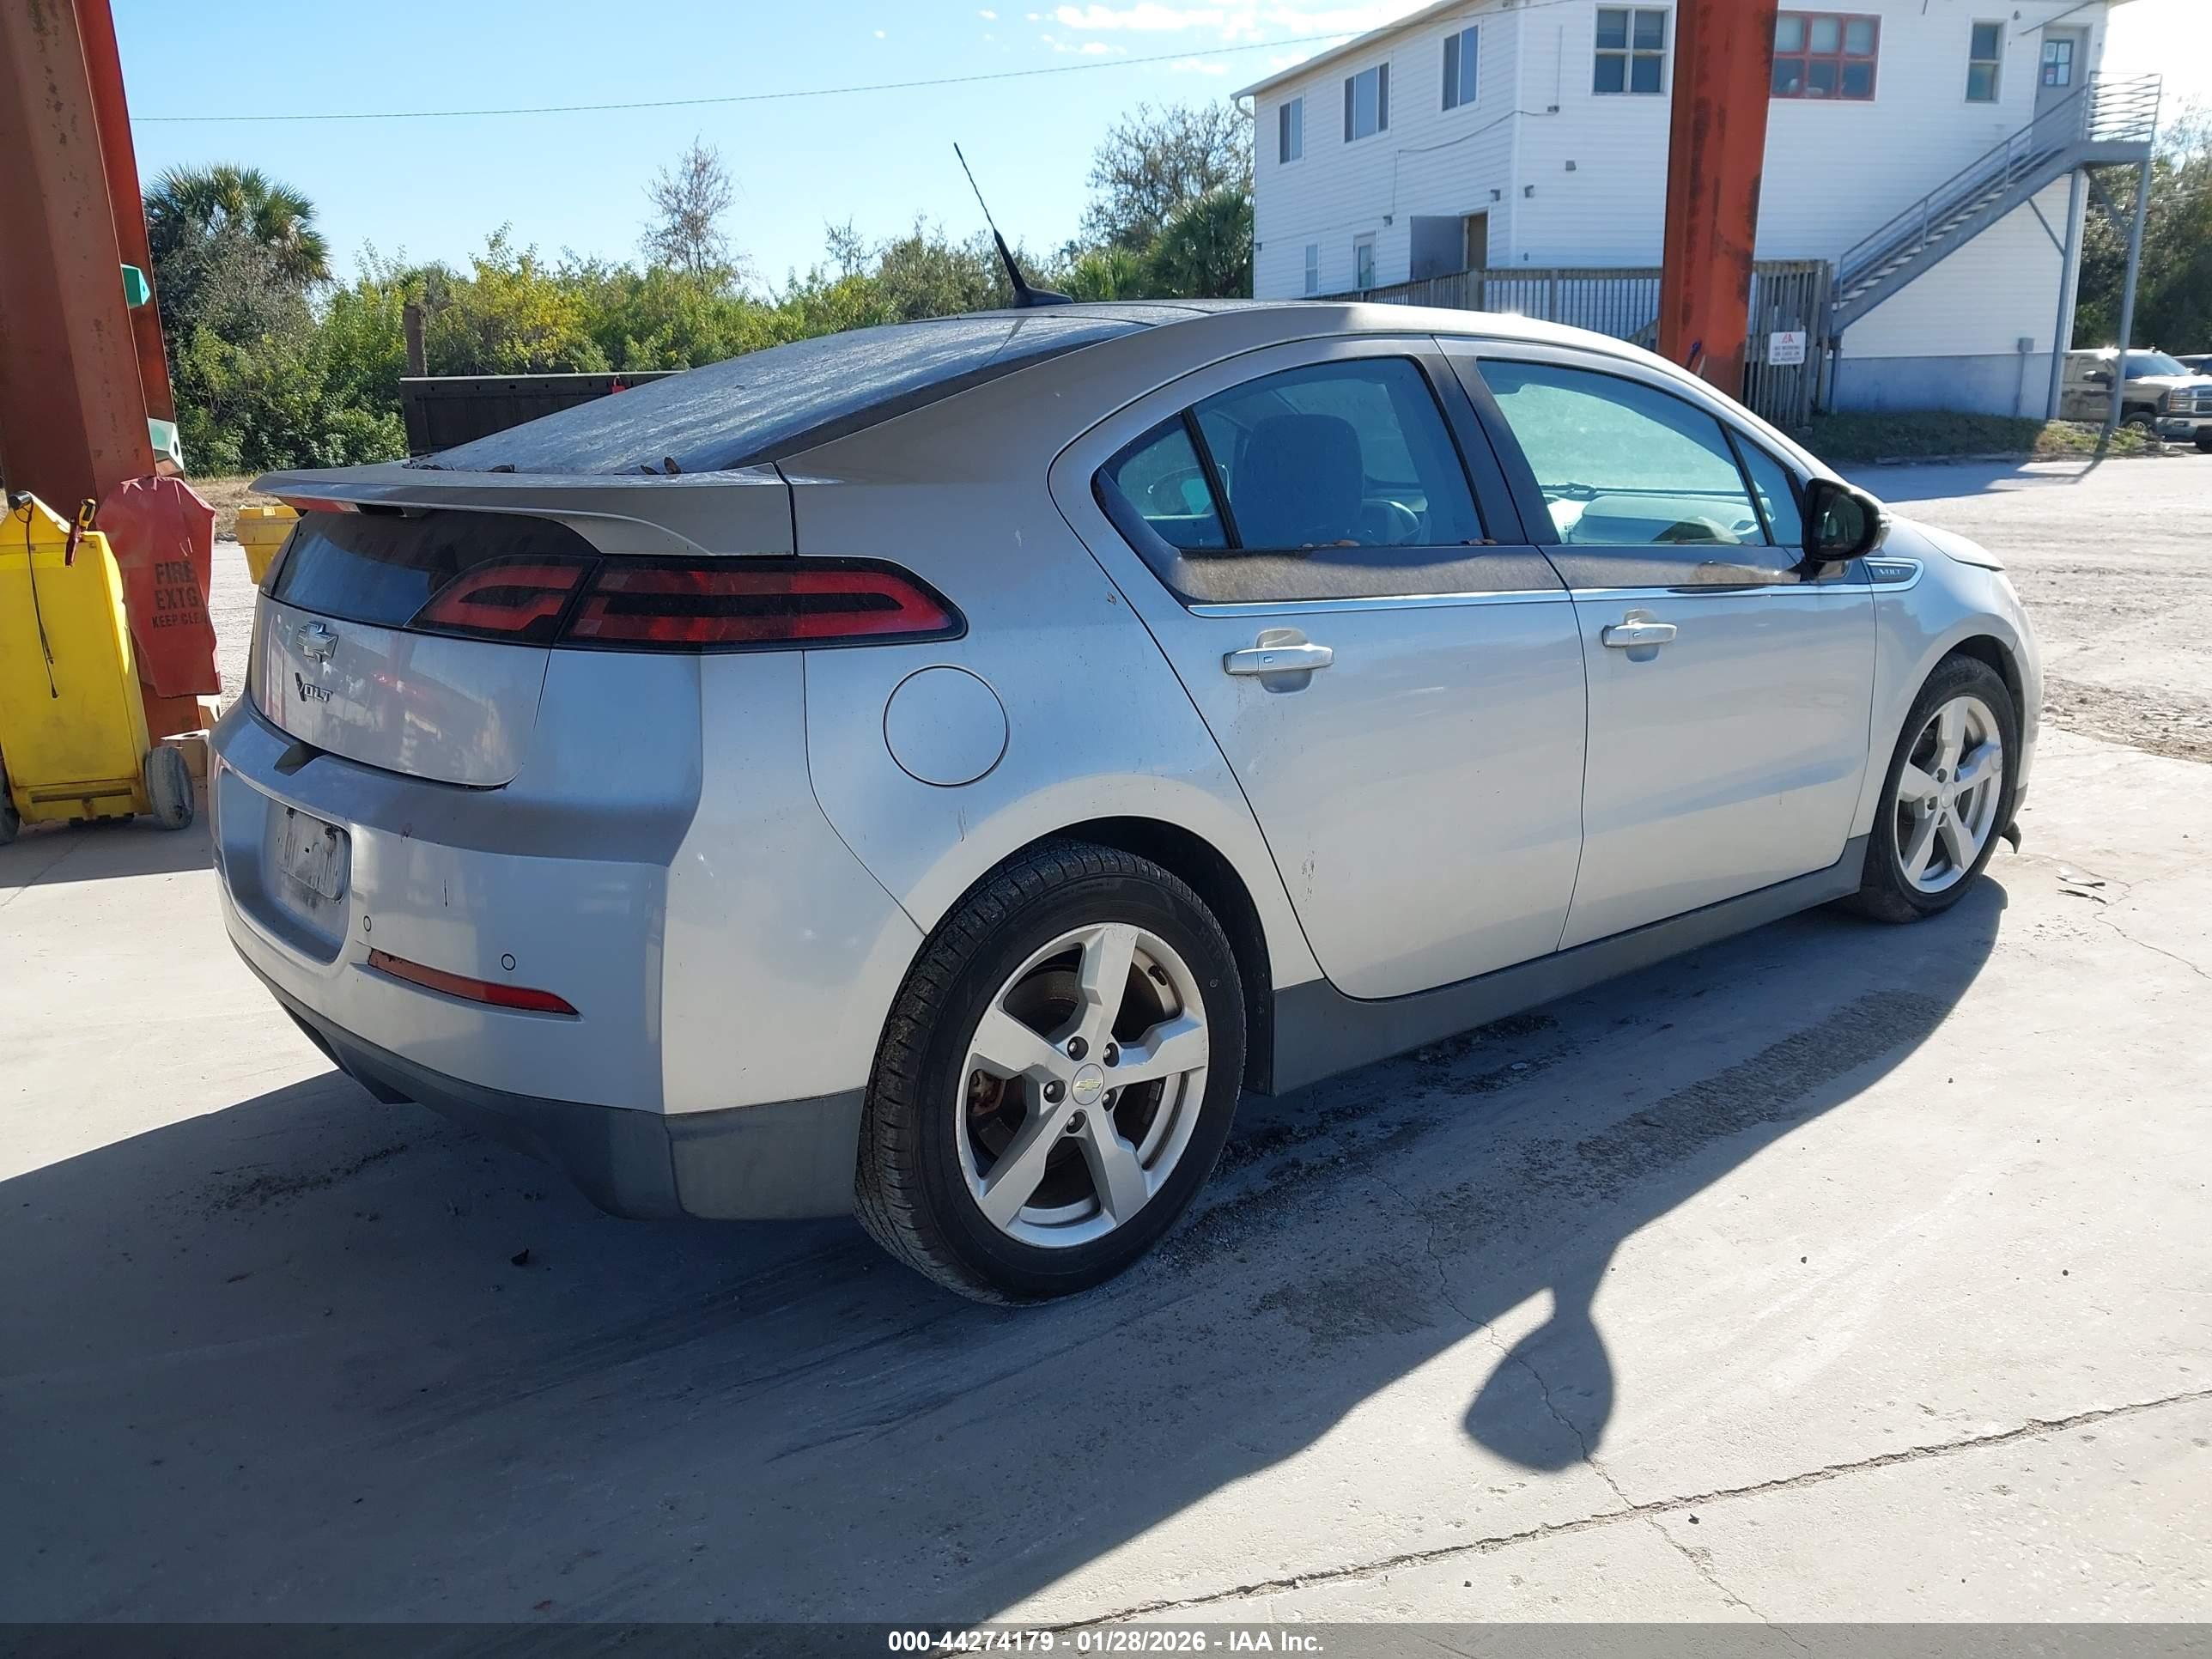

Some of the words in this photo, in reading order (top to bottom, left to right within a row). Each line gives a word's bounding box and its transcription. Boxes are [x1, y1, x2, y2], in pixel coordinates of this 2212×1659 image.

[155, 561, 194, 584] FIRE
[152, 613, 178, 629] KEEP
[180, 611, 209, 625] CLEA
[295, 672, 333, 702] VOLT
